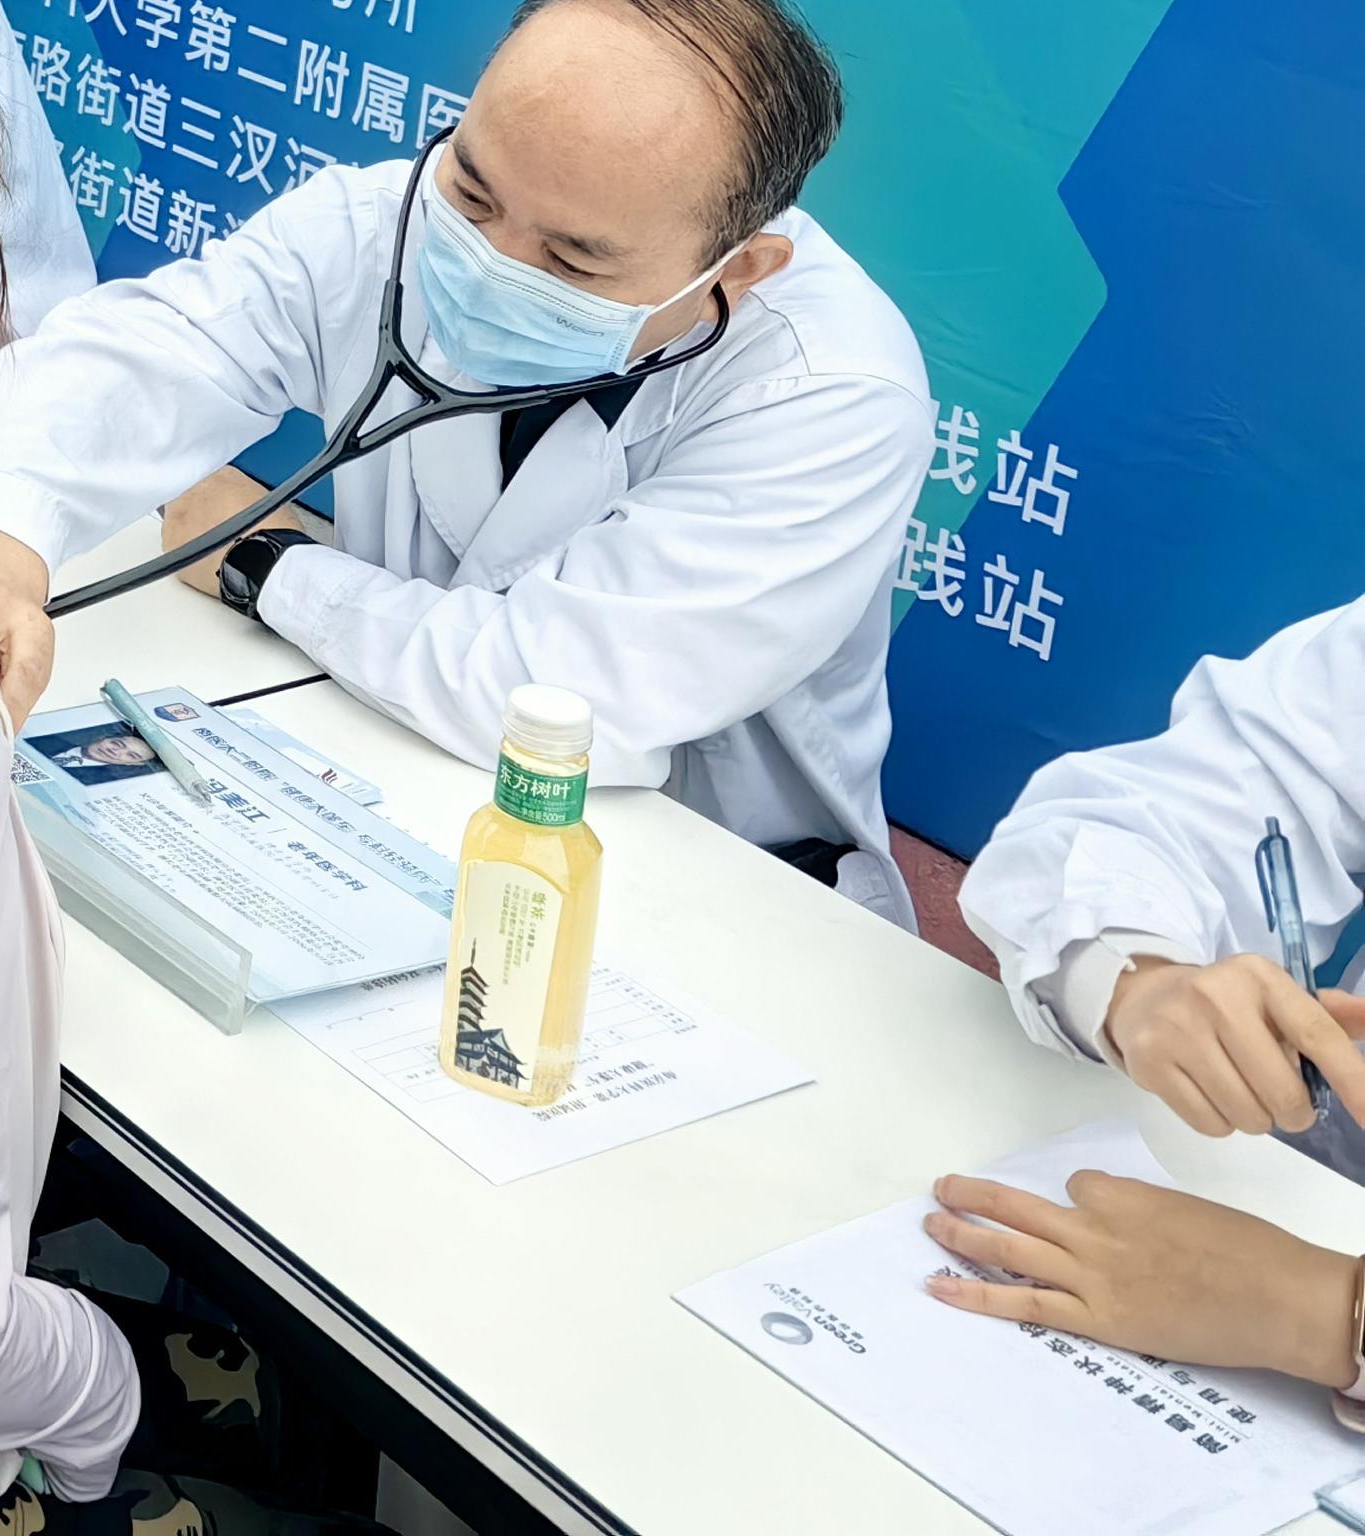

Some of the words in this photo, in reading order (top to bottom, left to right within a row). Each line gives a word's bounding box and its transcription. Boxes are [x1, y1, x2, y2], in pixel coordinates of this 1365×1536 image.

[54, 137, 246, 257] 街道新
[892, 516, 1064, 662] 践站
[500, 764, 572, 800] 东方树叶
[762, 1283, 813, 1318] Valley
[813, 1315, 867, 1355] Green
